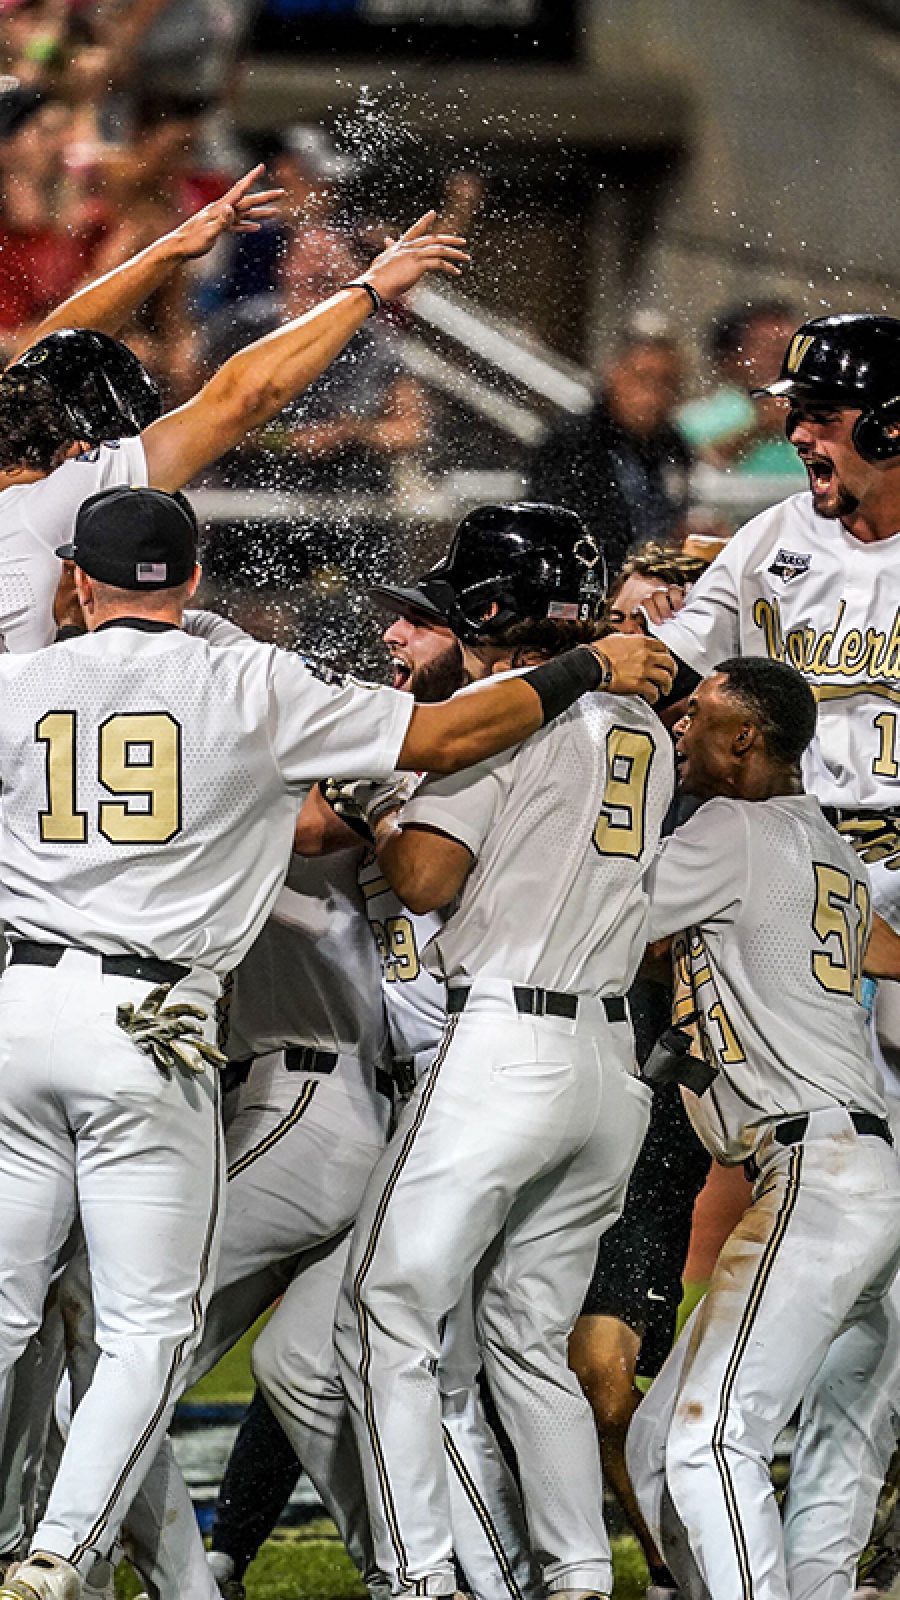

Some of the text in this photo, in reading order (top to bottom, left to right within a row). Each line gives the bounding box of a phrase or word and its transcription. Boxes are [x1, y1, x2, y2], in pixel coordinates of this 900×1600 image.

[35, 709, 183, 845] 19
[592, 724, 657, 862] 9
[872, 712, 899, 778] 1
